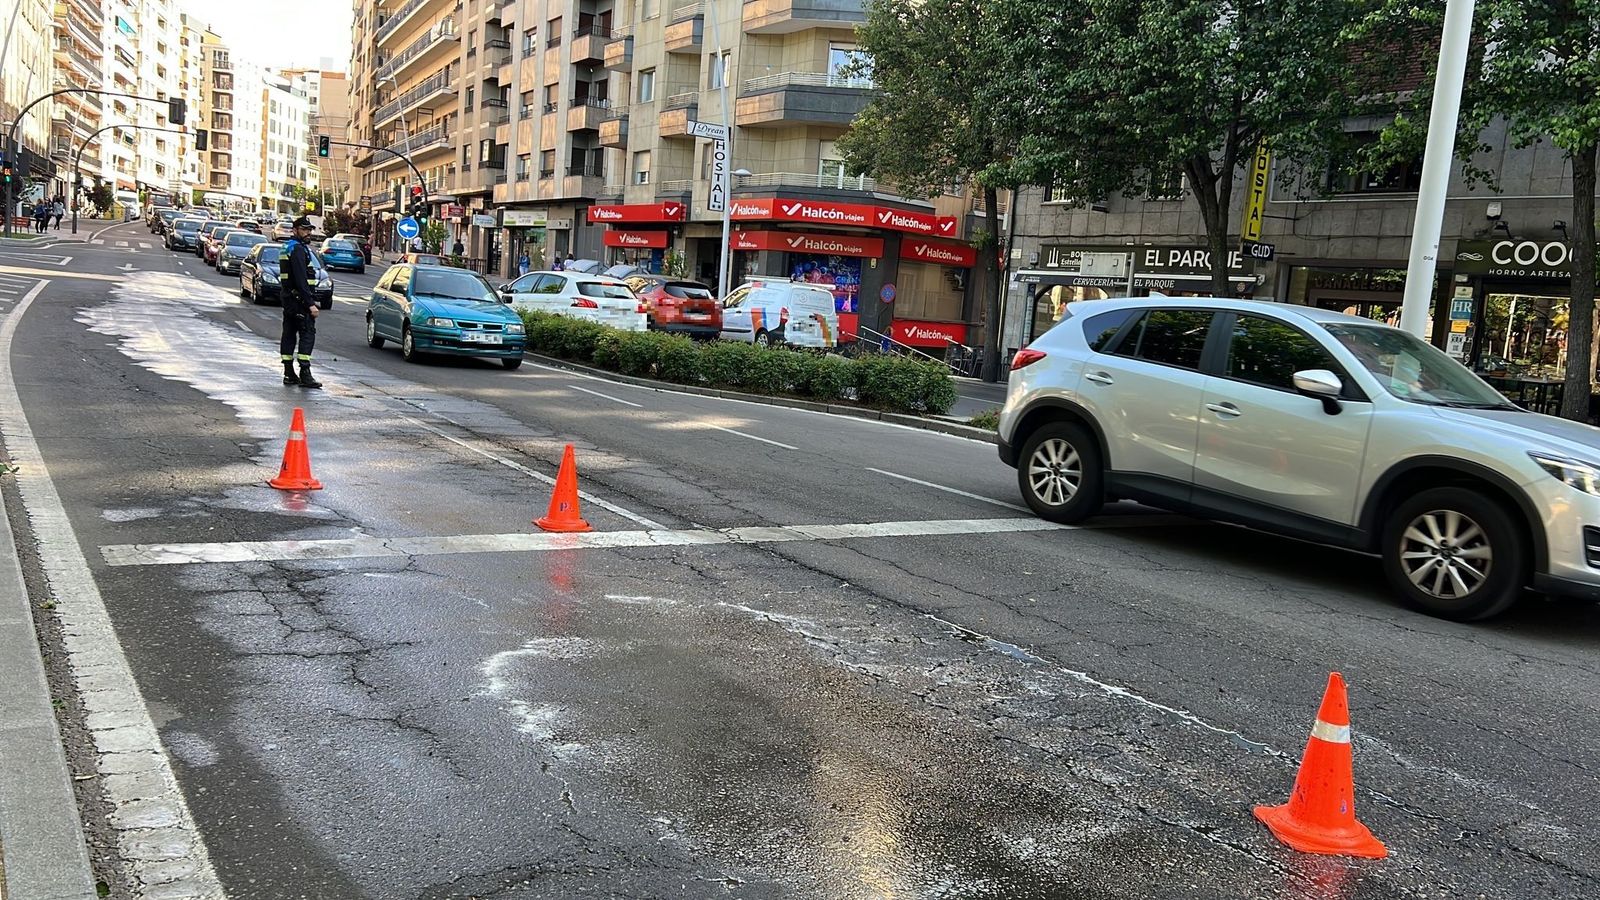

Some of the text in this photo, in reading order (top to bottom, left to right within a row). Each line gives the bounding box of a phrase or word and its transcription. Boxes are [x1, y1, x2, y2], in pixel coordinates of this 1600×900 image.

[711, 140, 726, 204] HOSTAL
[738, 205, 758, 215] Halcón
[801, 206, 864, 221] Halcón viajes
[892, 215, 918, 228] Halcón
[805, 239, 843, 251] Halcón
[926, 247, 951, 260] Halcón
[1145, 249, 1164, 266] EL
[1492, 240, 1573, 266] COO
[1488, 268, 1525, 276] HORNO
[1073, 277, 1114, 287] CERVECERÍA
[1134, 279, 1175, 290] EL PARQUE
[1453, 301, 1472, 313] HR
[917, 328, 941, 340] Halcón
